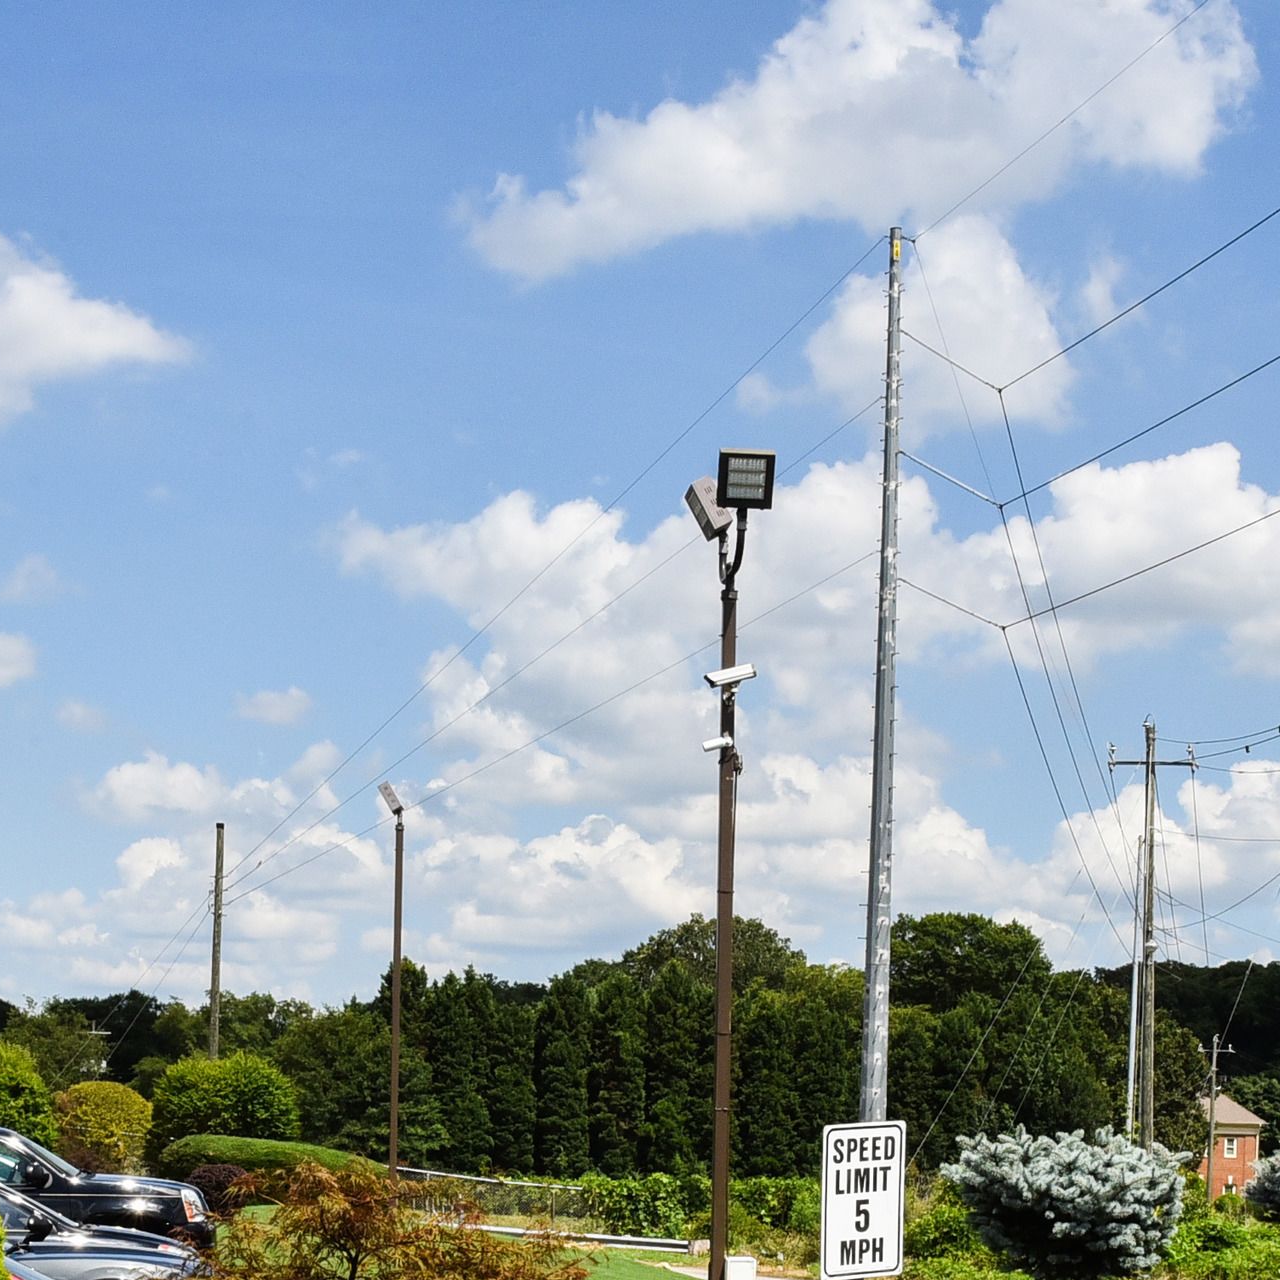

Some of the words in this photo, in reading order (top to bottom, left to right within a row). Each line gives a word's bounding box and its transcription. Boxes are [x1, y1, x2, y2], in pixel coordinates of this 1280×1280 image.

[832, 1135, 896, 1164] SPEED
[835, 1166, 892, 1195] LIMIT
[854, 1199, 870, 1233] 5
[840, 1237, 884, 1266] MPH
